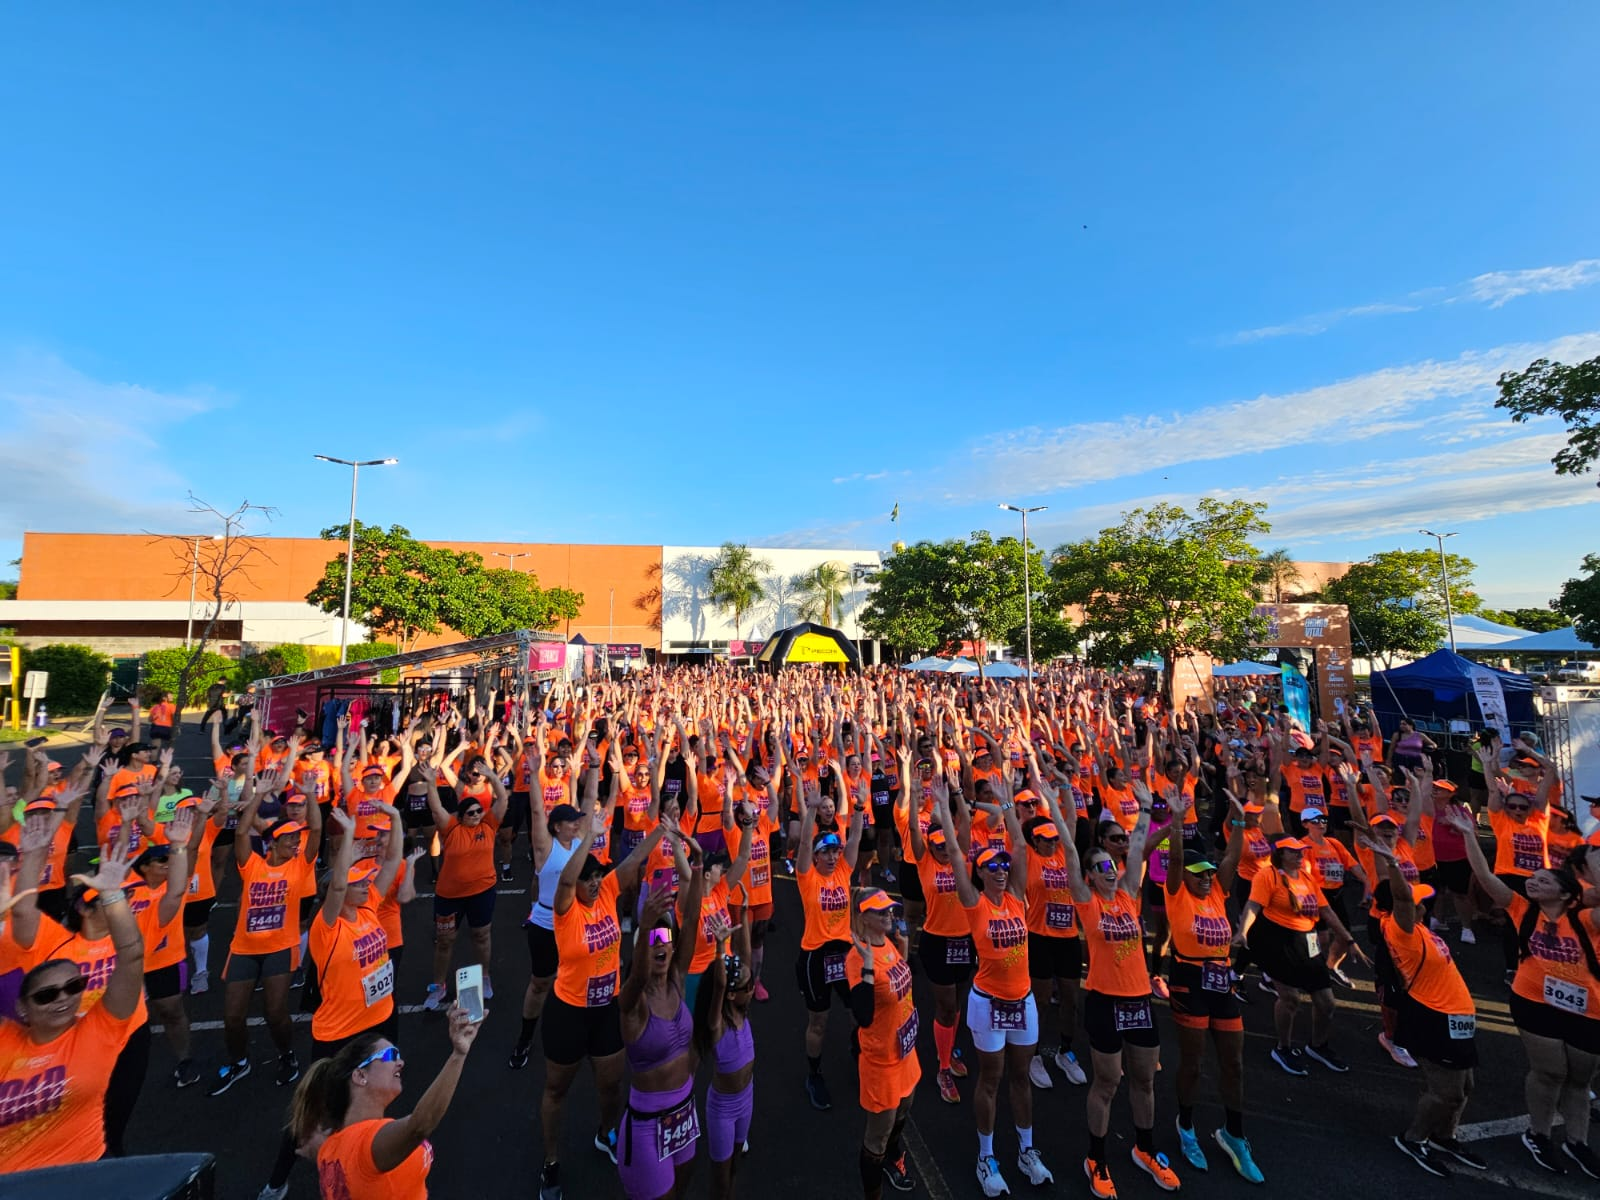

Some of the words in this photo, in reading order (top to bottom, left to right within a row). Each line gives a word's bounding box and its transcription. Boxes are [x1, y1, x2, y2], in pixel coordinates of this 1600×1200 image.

[250, 914, 281, 927] 5440
[1049, 911, 1071, 922] 5522
[946, 948, 969, 957] 5344
[826, 962, 844, 976] 535
[369, 972, 393, 997] 3027
[588, 983, 615, 999] 5586
[1544, 985, 1585, 1007] 3043
[993, 1010, 1022, 1022] 5349
[1118, 1009, 1146, 1022] 5348
[663, 1114, 693, 1146] 5490
